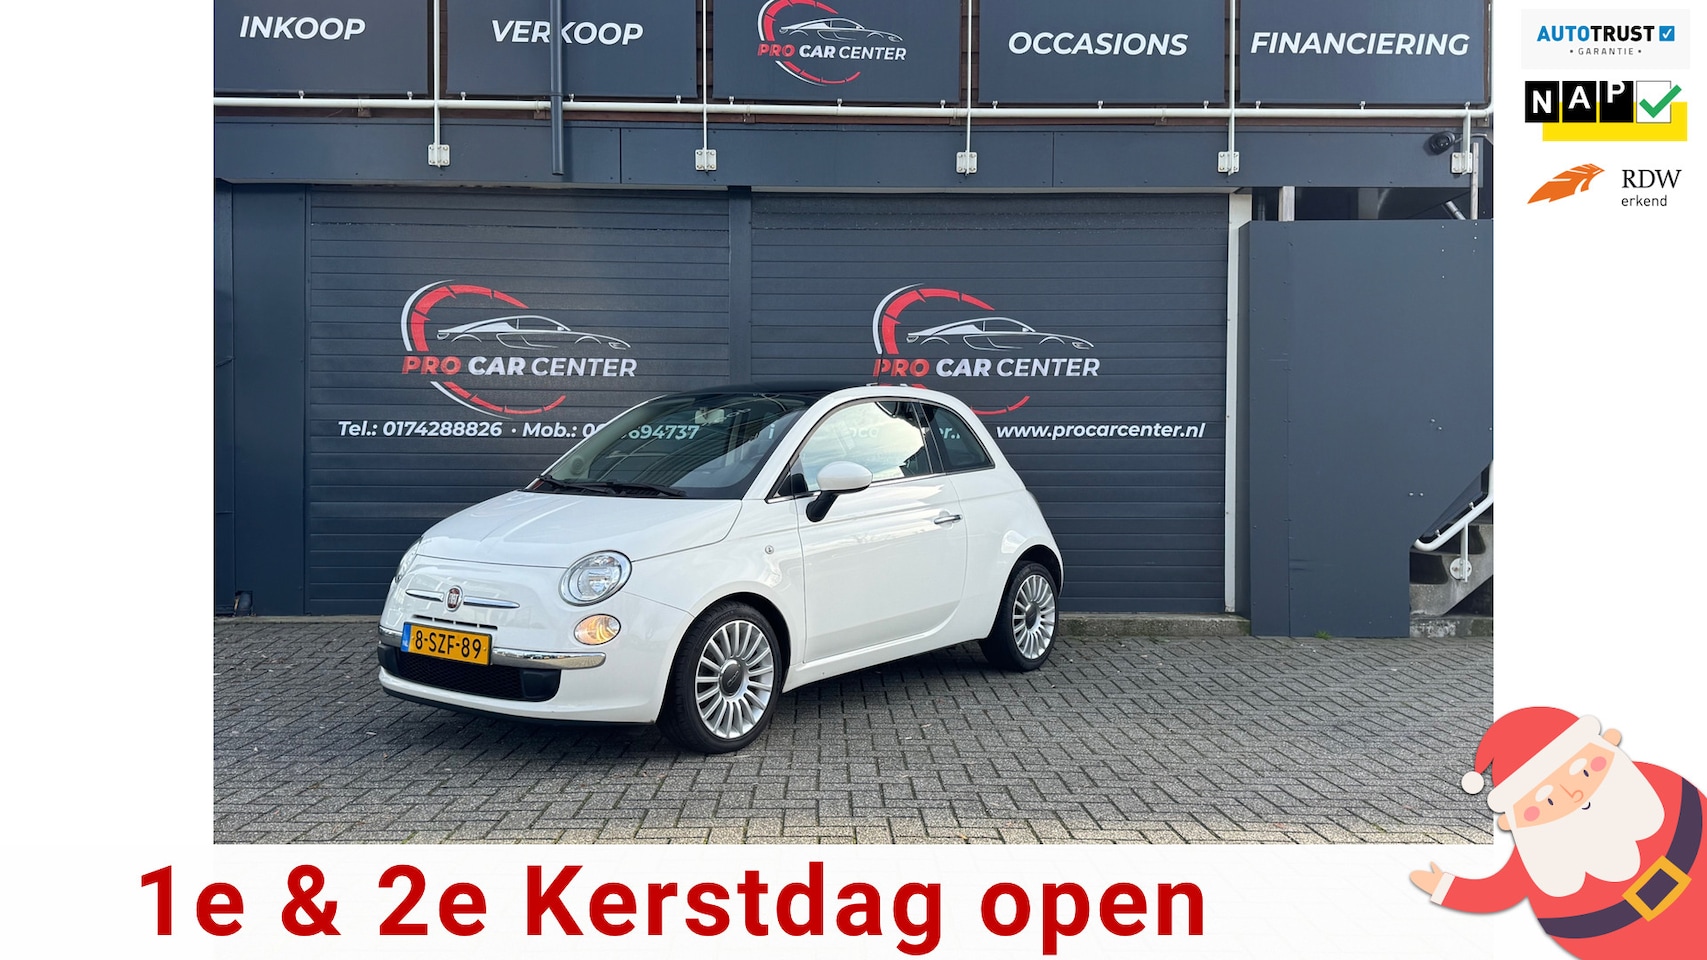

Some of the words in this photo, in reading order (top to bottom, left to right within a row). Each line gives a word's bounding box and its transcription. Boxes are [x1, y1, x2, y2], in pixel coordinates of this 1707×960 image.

[239, 15, 366, 41] INKOOP
[491, 19, 644, 46] VERKOOP
[757, 43, 796, 57] PRO
[799, 44, 836, 59] CAR
[838, 46, 907, 61] CENTER
[1008, 31, 1189, 56] OCCASIONS
[1250, 31, 1471, 56] FINANCIERING
[402, 356, 461, 376] PRO
[467, 355, 527, 377] CAR
[530, 357, 638, 377] CENTER
[872, 358, 930, 378] PRO
[935, 358, 992, 378] CAR
[996, 358, 1101, 378] CENTER
[338, 420, 378, 437] Tel.:
[382, 421, 504, 438] 0174288826
[522, 422, 578, 439] Mob.:
[998, 421, 1206, 442] www.procarcenter.nl
[415, 630, 482, 660] 8-SZF-89
